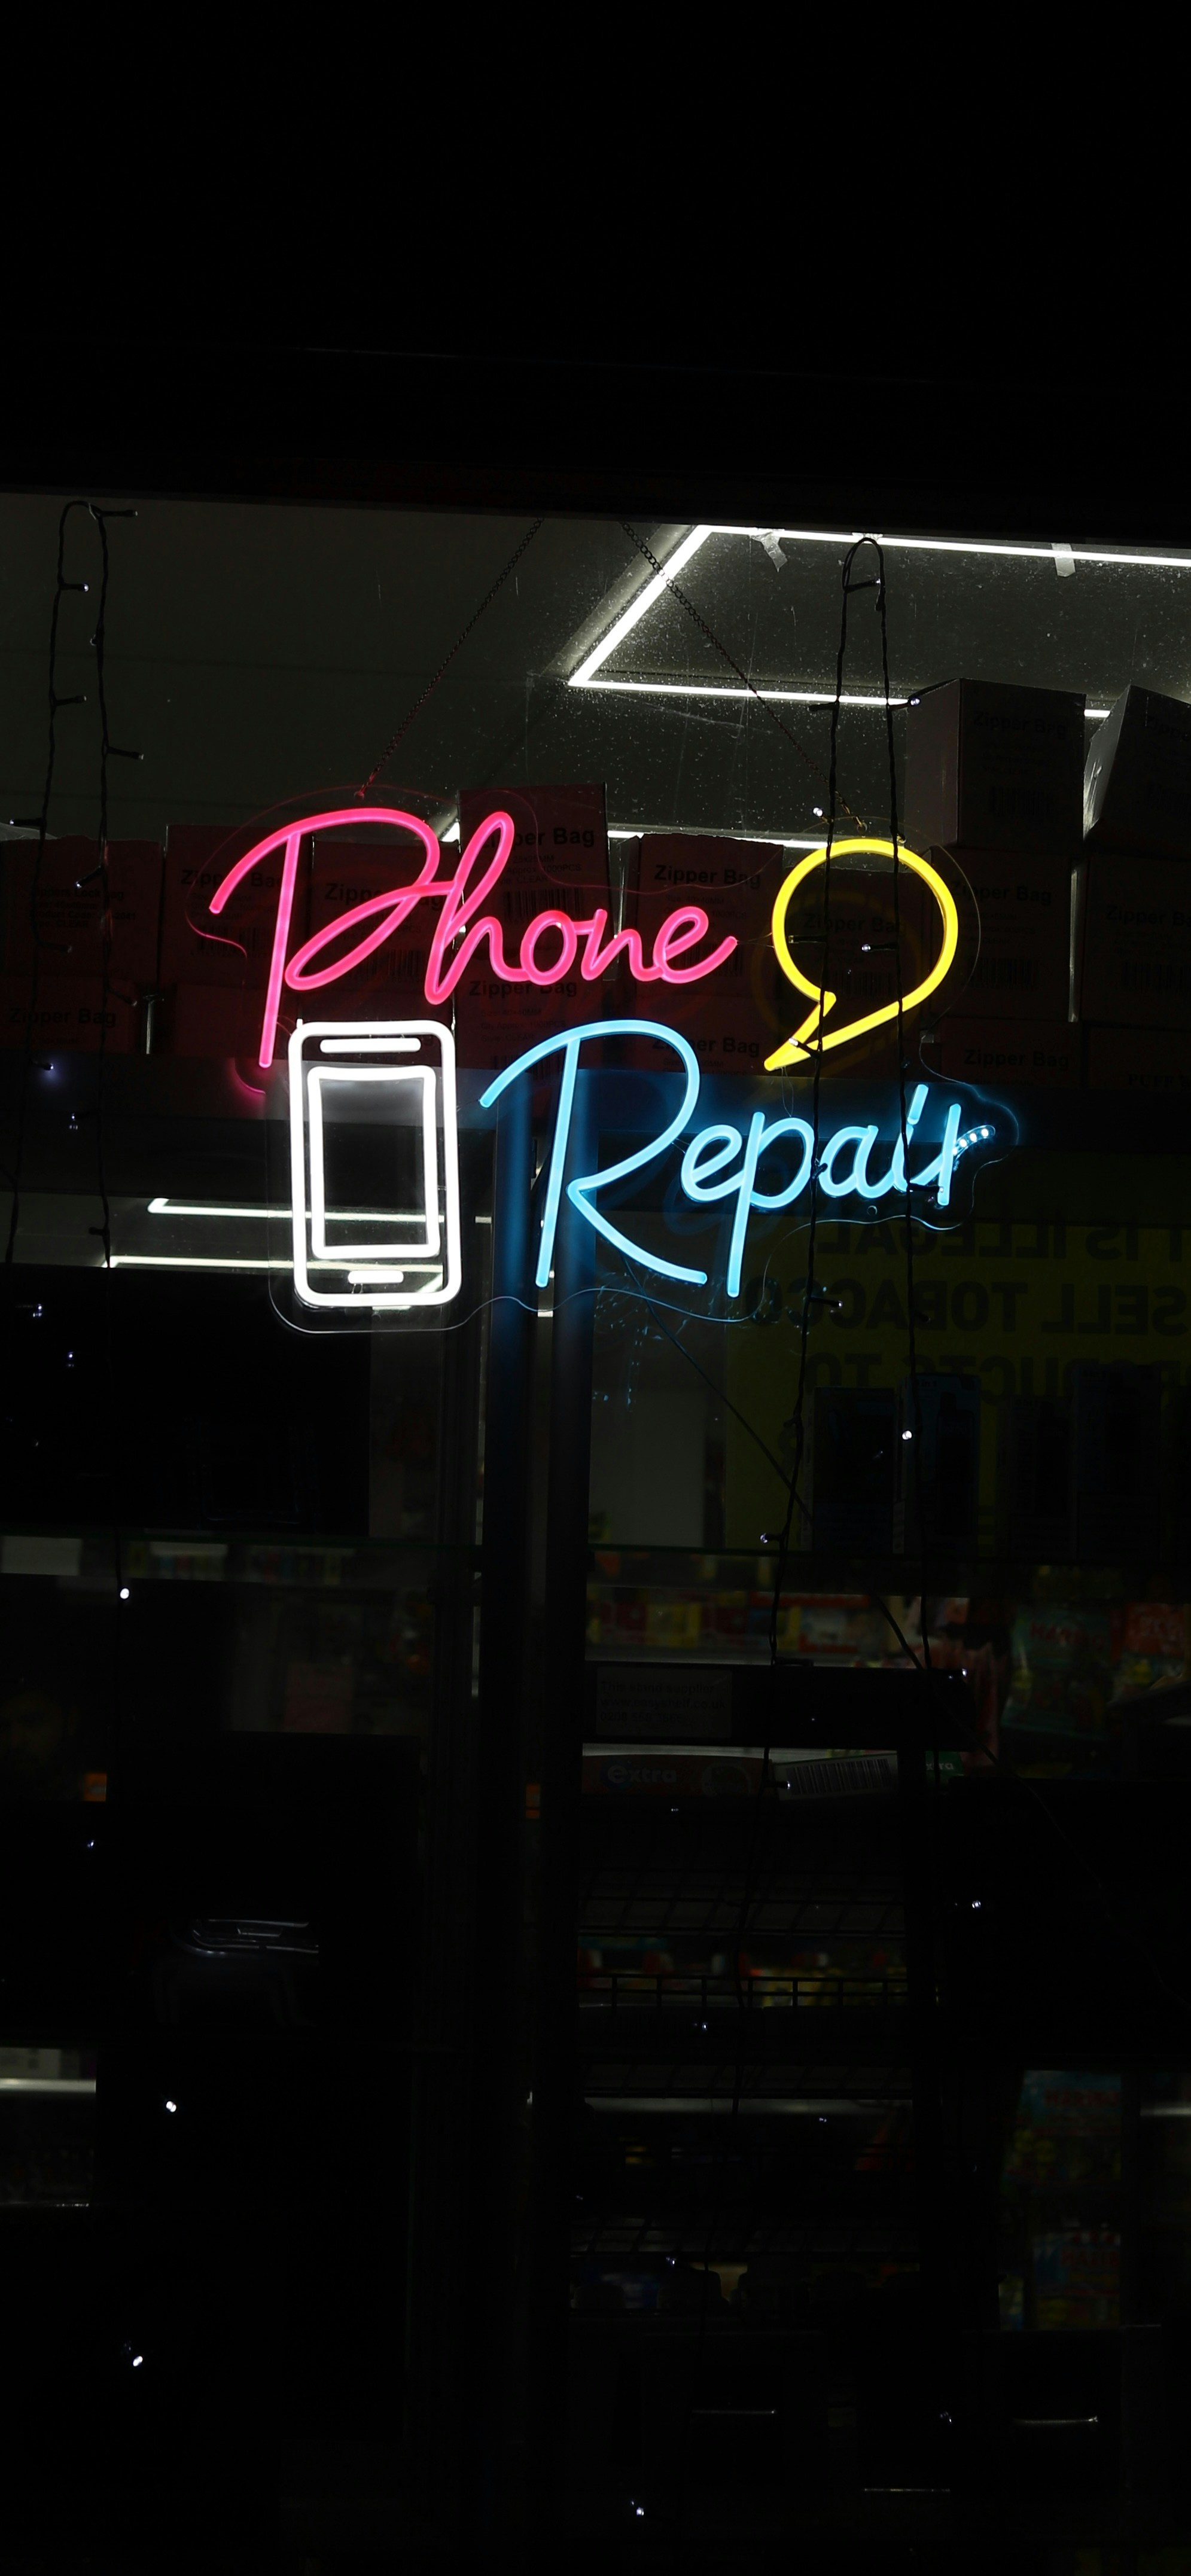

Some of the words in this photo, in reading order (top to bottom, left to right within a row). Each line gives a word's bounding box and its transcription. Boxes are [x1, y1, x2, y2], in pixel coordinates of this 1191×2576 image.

[973, 711, 1030, 732] Zipper
[1035, 718, 1066, 740] Bag
[482, 829, 545, 850] iper
[553, 827, 595, 848] Bag
[181, 869, 233, 888] Zipp
[654, 864, 717, 885] Zipper
[724, 869, 760, 889] Bag
[32, 888, 71, 898] ippers
[75, 888, 100, 898] Lock
[103, 890, 124, 901] ag
[325, 883, 384, 906] Zipp
[951, 880, 1010, 903] Zipper
[1016, 885, 1052, 906] Bag
[803, 913, 865, 933] Zipper
[1106, 904, 1166, 926] Zipper
[208, 806, 739, 1069] Phone
[469, 980, 534, 999] Zipper
[540, 981, 577, 998] Bag
[8, 1007, 72, 1028] Zipper
[78, 1008, 116, 1028] Bag
[652, 1037, 716, 1054] Zer
[723, 1037, 760, 1058] Bag
[964, 1048, 1026, 1069] Zipper
[1033, 1050, 1068, 1072] Bag
[479, 1018, 995, 1299] Repair
[600, 1680, 626, 1692] This
[607, 1764, 677, 1784] extra
[925, 1761, 955, 1770] xra
